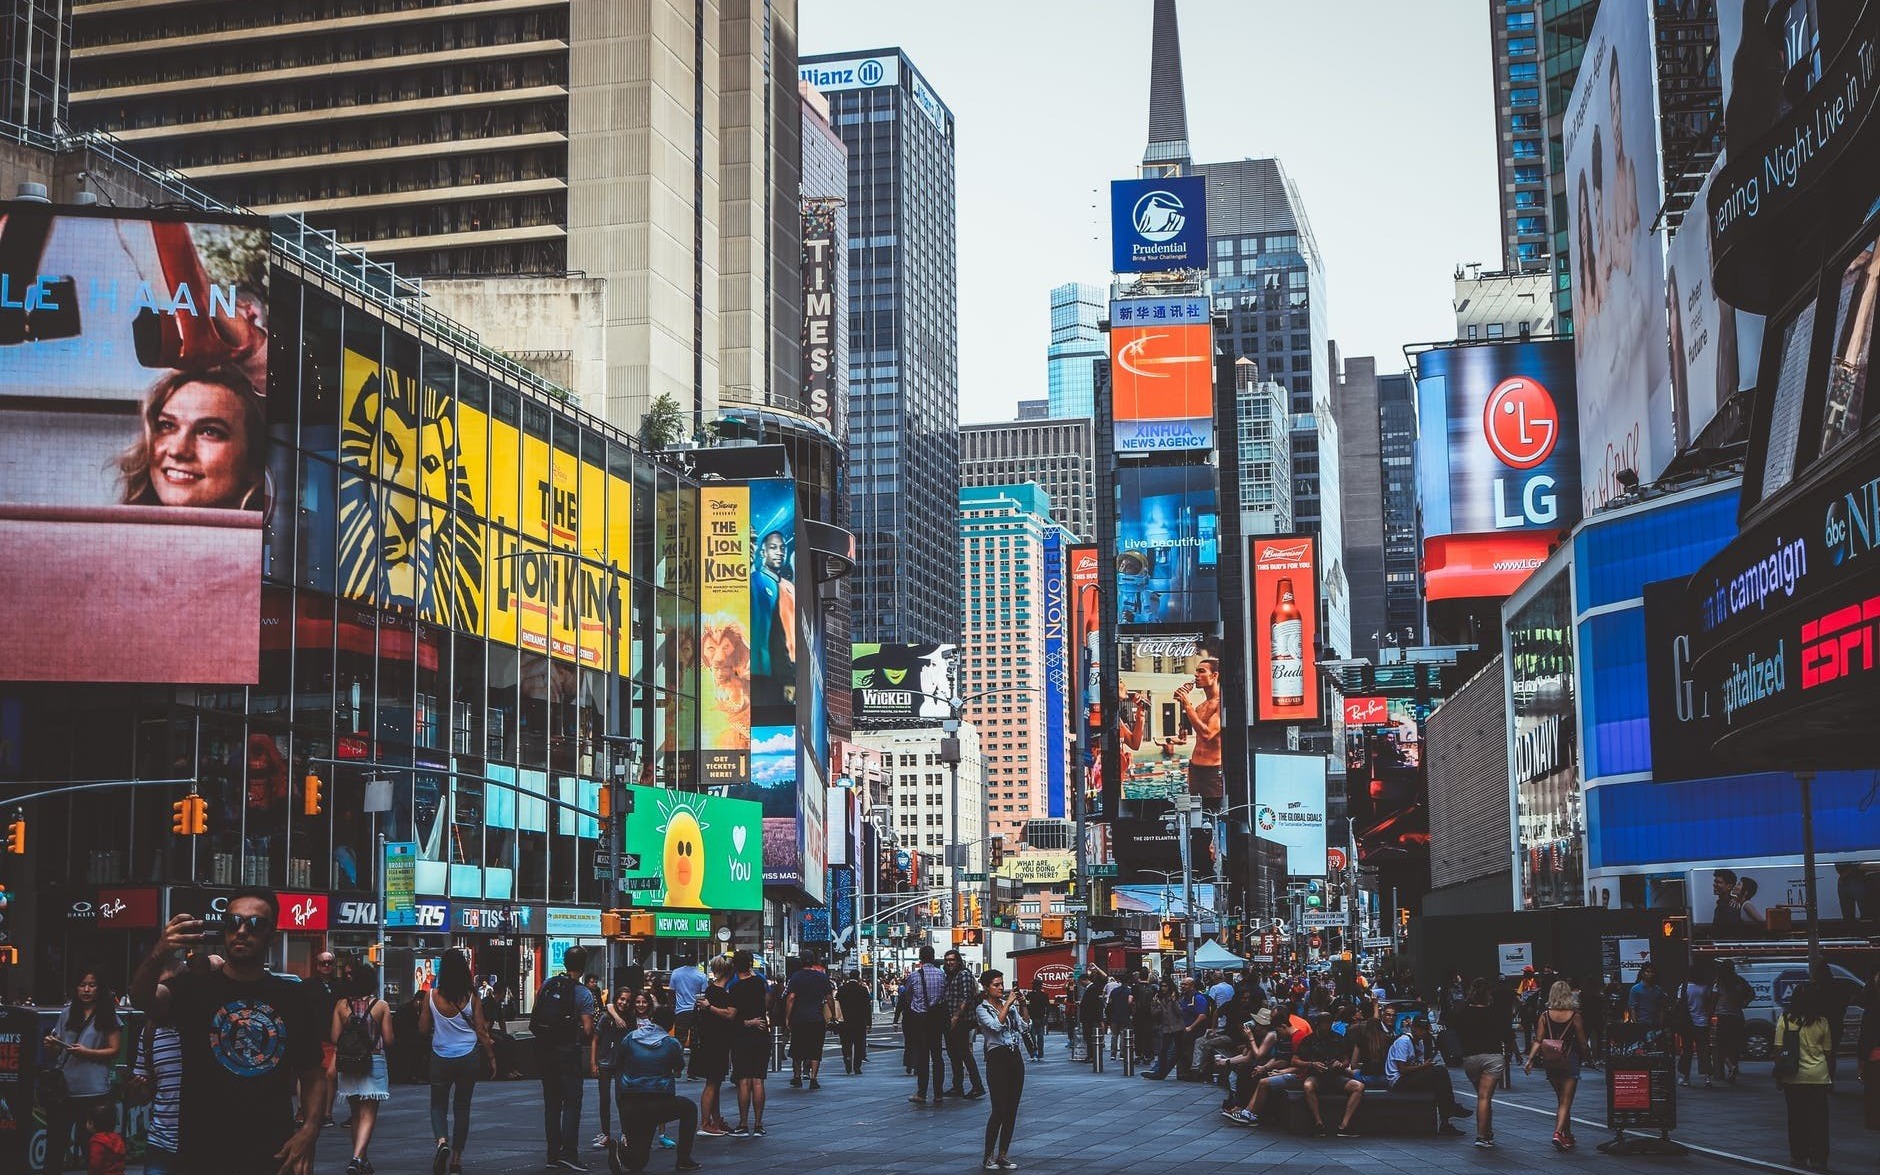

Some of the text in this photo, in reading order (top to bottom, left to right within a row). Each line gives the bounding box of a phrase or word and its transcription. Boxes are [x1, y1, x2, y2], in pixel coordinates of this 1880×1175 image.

[800, 69, 853, 86] llianz
[1715, 176, 1758, 239] ening
[1764, 126, 1814, 194] Night
[1816, 96, 1844, 148] Live
[1846, 72, 1858, 112] in
[1132, 242, 1186, 255] Prudential
[0, 273, 238, 318] LE HAAN
[806, 239, 831, 372] TIMES
[1119, 304, 1200, 320] 新华通讯社
[1688, 328, 1708, 366] future
[1136, 424, 1193, 438] XINHUA
[1122, 436, 1206, 448] NEWS AGENCY
[538, 480, 577, 532] THE
[708, 500, 738, 511] Disney
[1494, 475, 1558, 529] LG
[711, 521, 736, 532] THE
[1826, 518, 1846, 548] abc
[707, 536, 742, 556] LION
[1124, 536, 1205, 550] Live beautiful
[498, 516, 558, 612] LION
[704, 558, 748, 583] KING
[1716, 578, 1727, 624] in
[1730, 537, 1807, 614] campaign
[552, 639, 561, 650] ON
[1722, 639, 1785, 724] pitalized
[1346, 700, 1384, 720] Ray-Ban
[1515, 714, 1558, 784] OLD NAVY
[1278, 812, 1322, 822] THE GLOBAL GOALS
[1089, 866, 1095, 875] W
[1098, 866, 1108, 874] 44
[630, 880, 638, 889] W
[641, 880, 650, 889] 44
[100, 898, 126, 919] Ray-Ban
[292, 898, 318, 927] Ray-Ban
[659, 919, 672, 930] NEW
[674, 919, 688, 930] YORK
